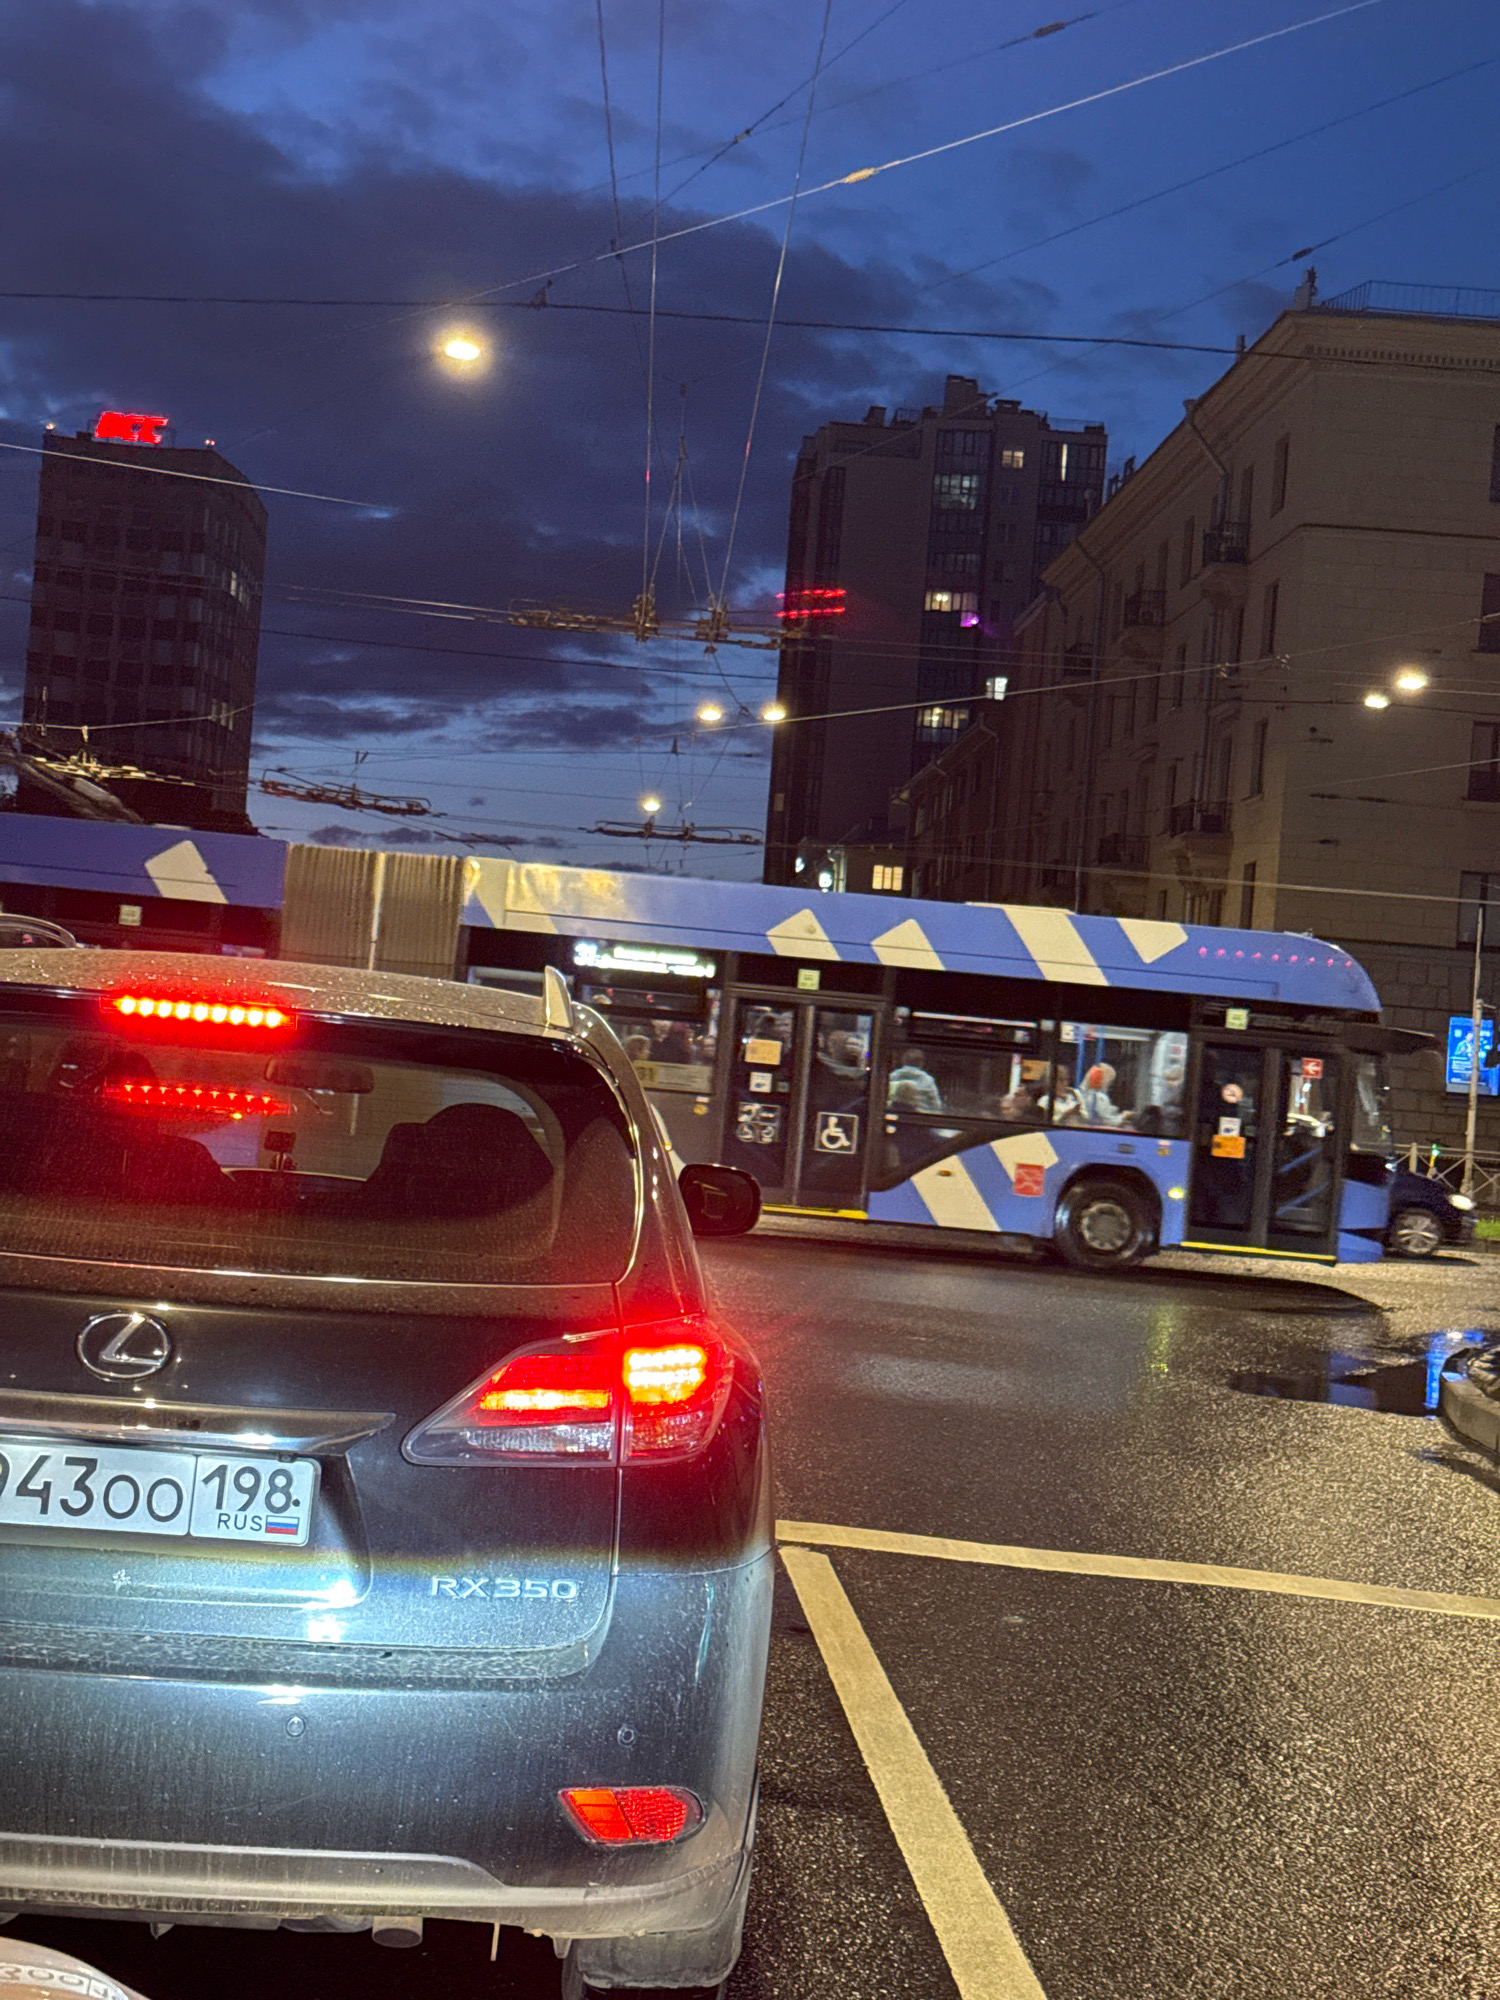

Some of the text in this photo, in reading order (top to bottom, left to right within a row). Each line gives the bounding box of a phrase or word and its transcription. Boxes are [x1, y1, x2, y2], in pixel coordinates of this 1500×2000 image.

[0, 1452, 294, 1523] 43OO 198
[217, 1513, 263, 1531] RUS
